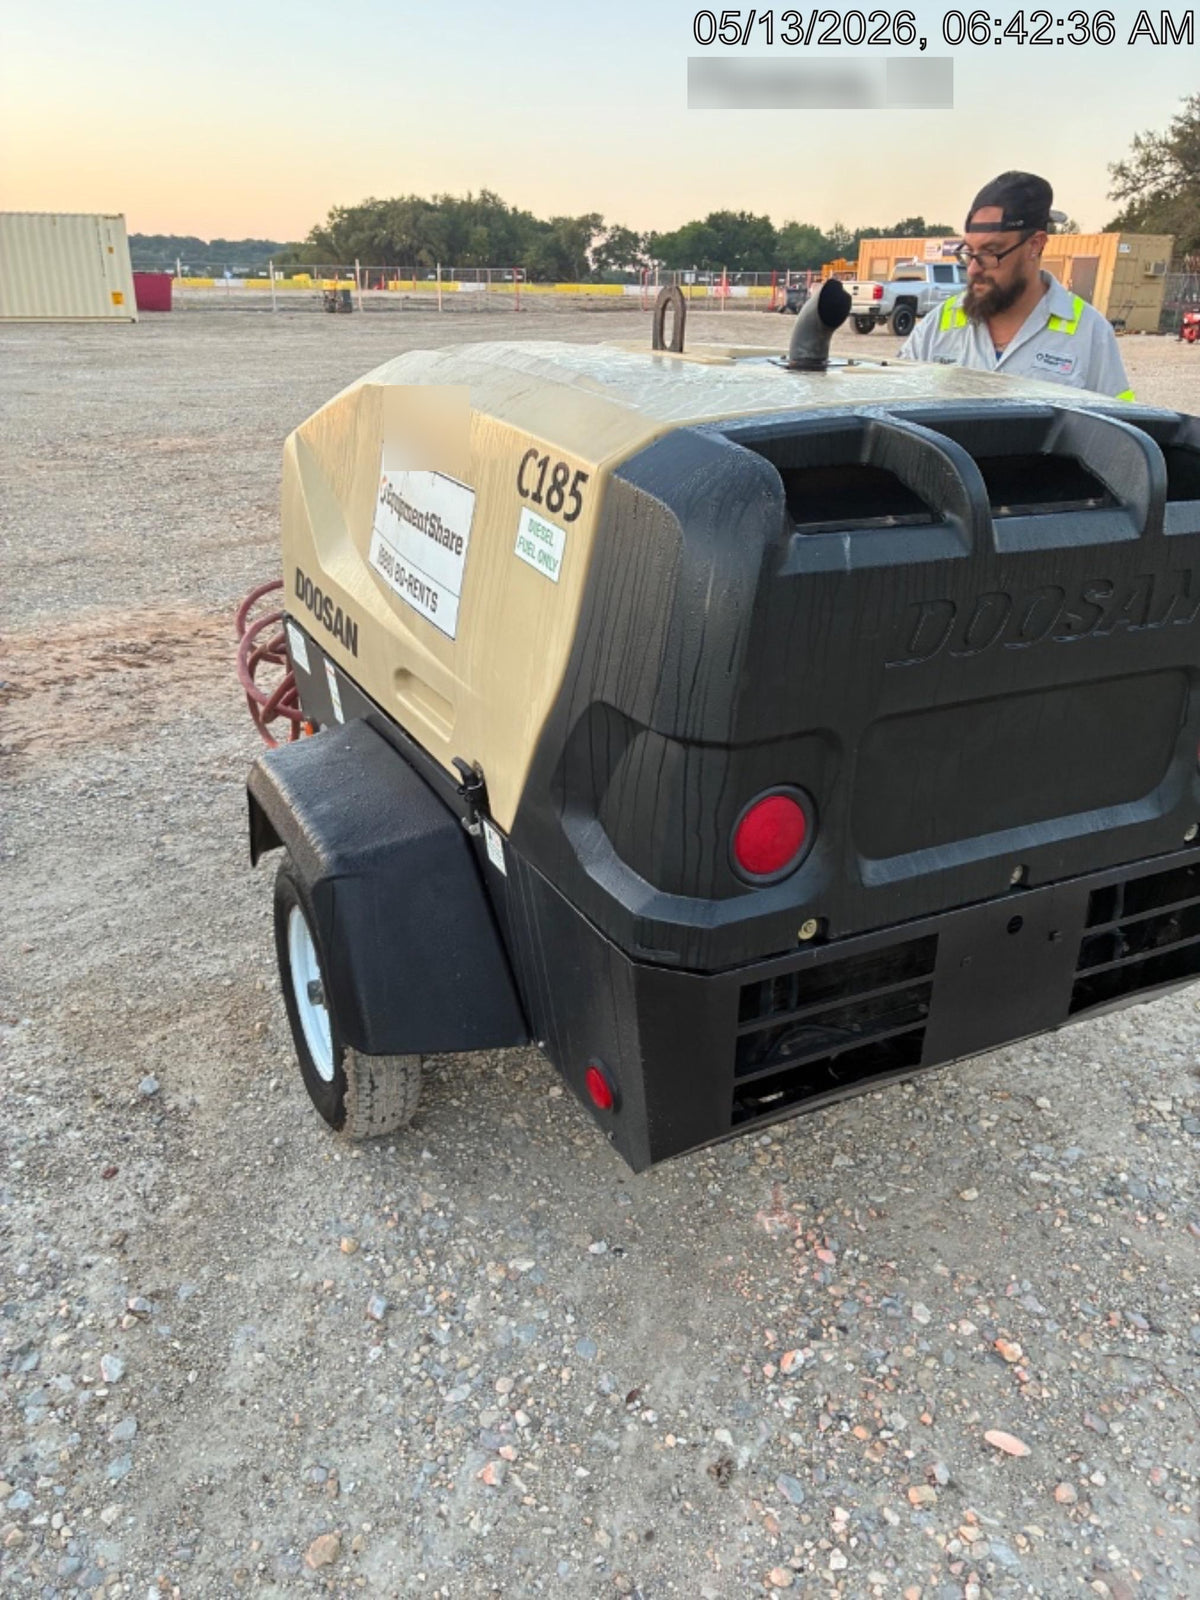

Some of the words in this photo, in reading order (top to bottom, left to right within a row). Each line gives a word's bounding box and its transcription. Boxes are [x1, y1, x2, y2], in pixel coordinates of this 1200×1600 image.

[517, 448, 589, 522] C185
[517, 537, 537, 560] FUEL
[538, 549, 559, 574] ONLY
[528, 517, 554, 547] DIESEL
[295, 566, 358, 659] DOOSAN
